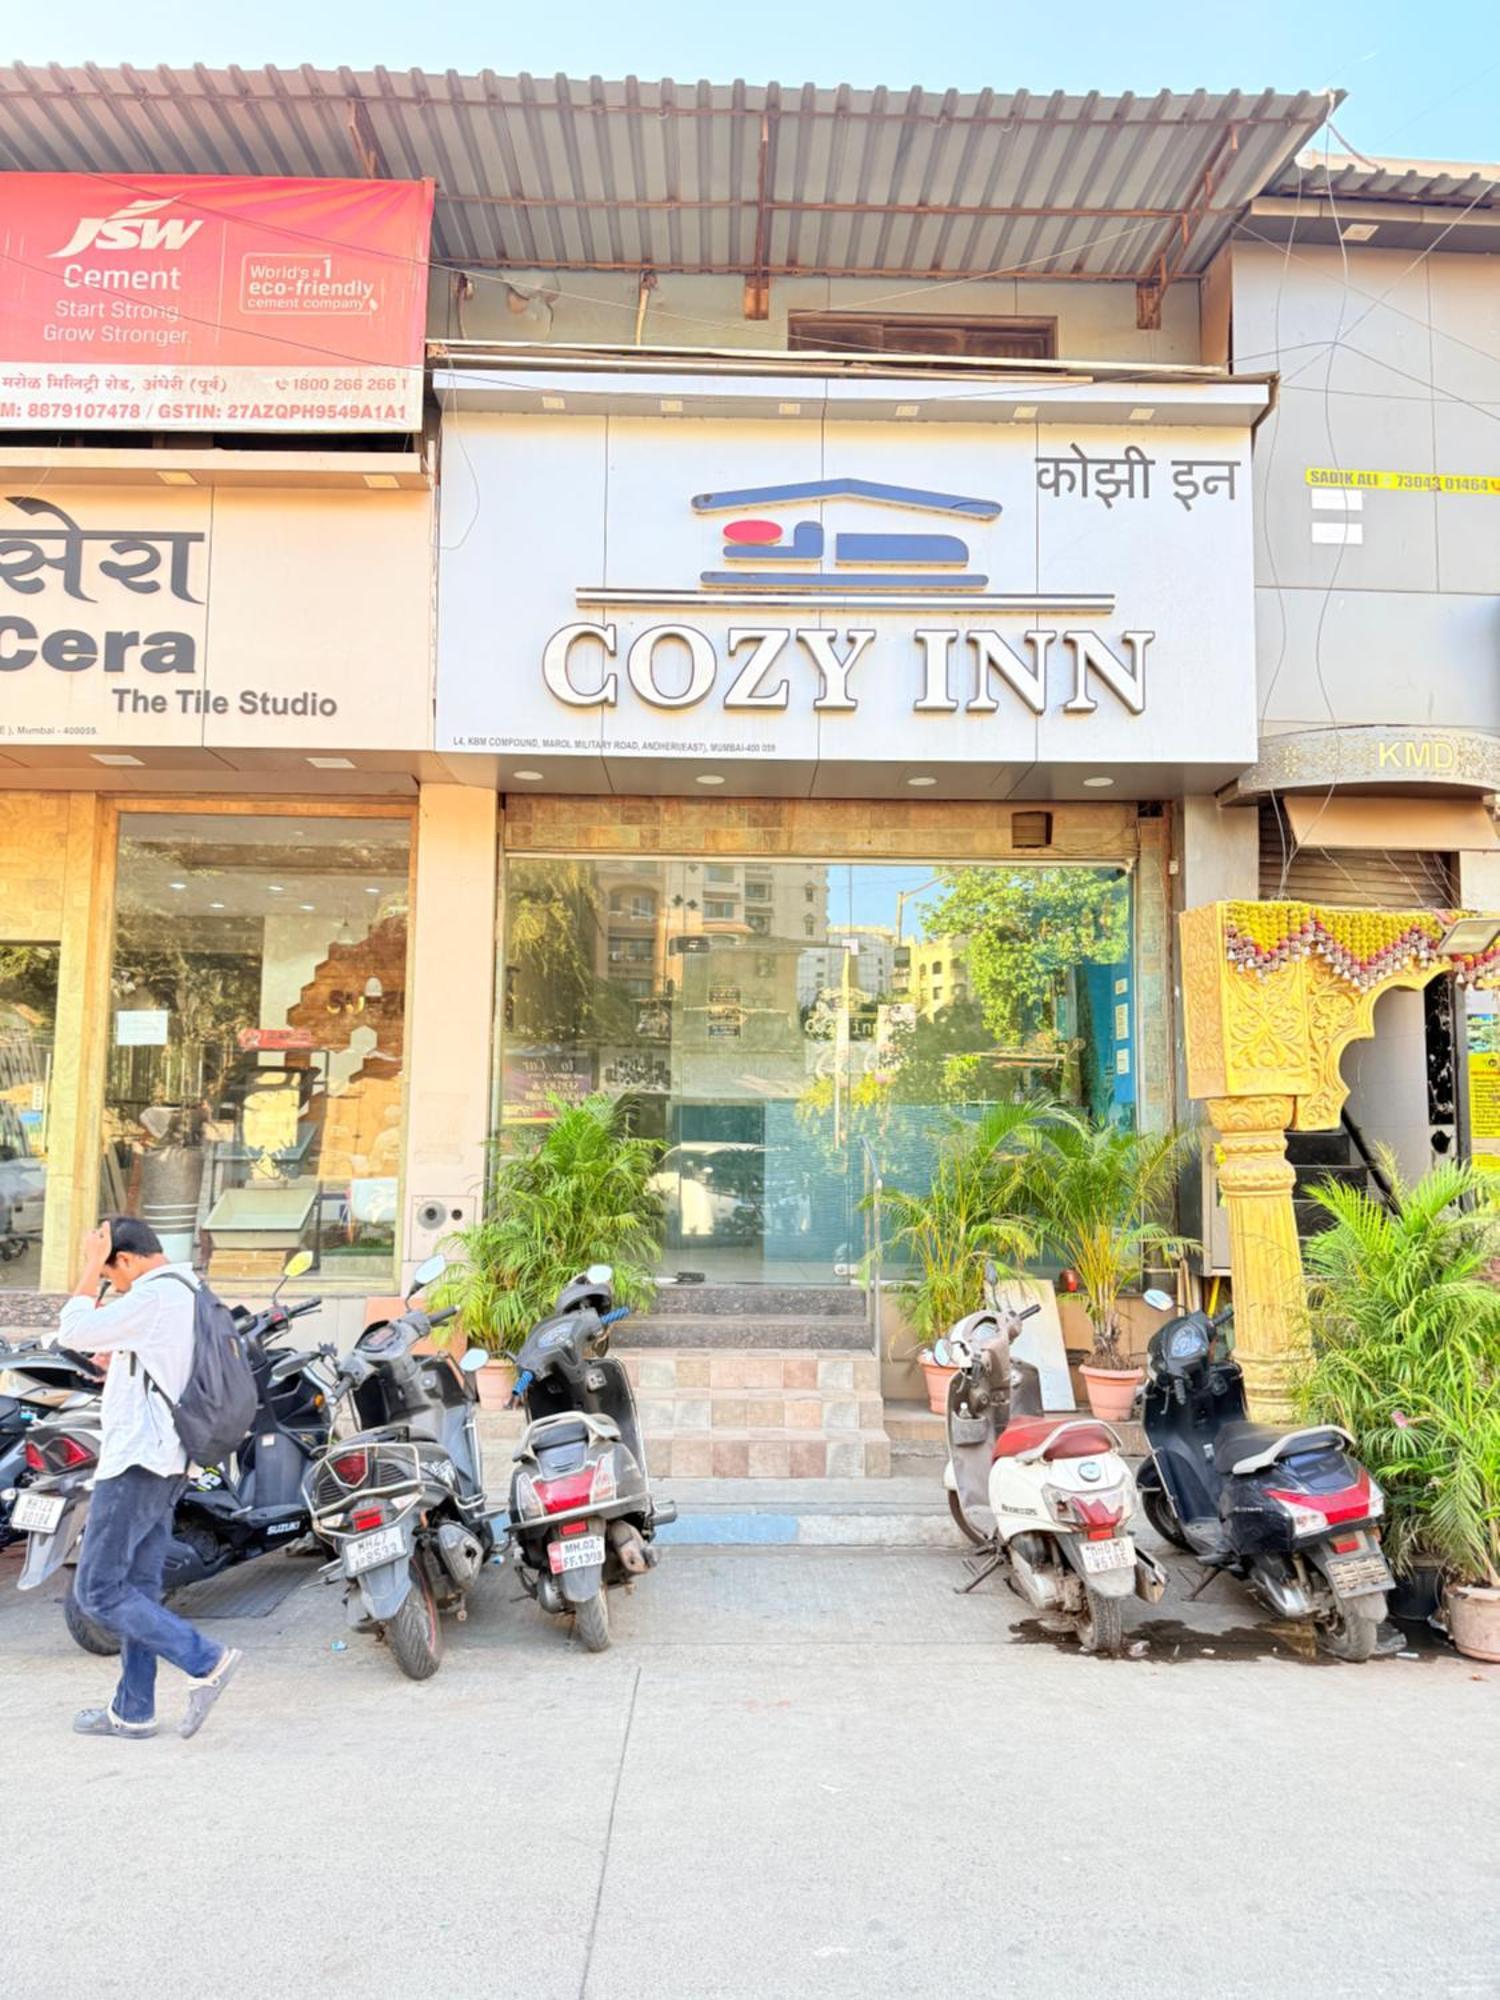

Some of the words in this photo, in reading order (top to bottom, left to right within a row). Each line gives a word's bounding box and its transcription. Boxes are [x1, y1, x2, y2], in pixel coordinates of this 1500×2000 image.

[45, 217, 205, 259] JSW
[64, 263, 182, 291] Cement
[250, 265, 310, 279] World's
[249, 280, 374, 299] eco-friendly
[56, 300, 105, 319] Start
[111, 301, 182, 322] Strong.
[248, 299, 299, 310] cement
[303, 299, 365, 311] company
[43, 324, 95, 343] Grow
[101, 326, 192, 347] Stronger.
[2, 372, 41, 389] मरोळ
[294, 378, 329, 391] 1800
[334, 378, 362, 391] 266
[367, 378, 396, 391] 266
[27, 403, 140, 418] 8879107478
[158, 404, 221, 419] GSTIN:
[1035, 443, 1156, 509] कोझी
[1171, 460, 1241, 511] इन
[1311, 470, 1353, 485] SADIK
[1357, 472, 1379, 486] ALI
[541, 622, 877, 712] COZY
[913, 628, 1157, 716] INN
[112, 688, 167, 712] The
[175, 689, 229, 714] Tile
[239, 689, 337, 717] Studio
[488, 737, 540, 749] COMPOUND,
[542, 738, 573, 749] MAROL
[574, 739, 612, 750] MILITARY
[613, 740, 640, 751] ROAD,
[1378, 742, 1454, 769] KMD
